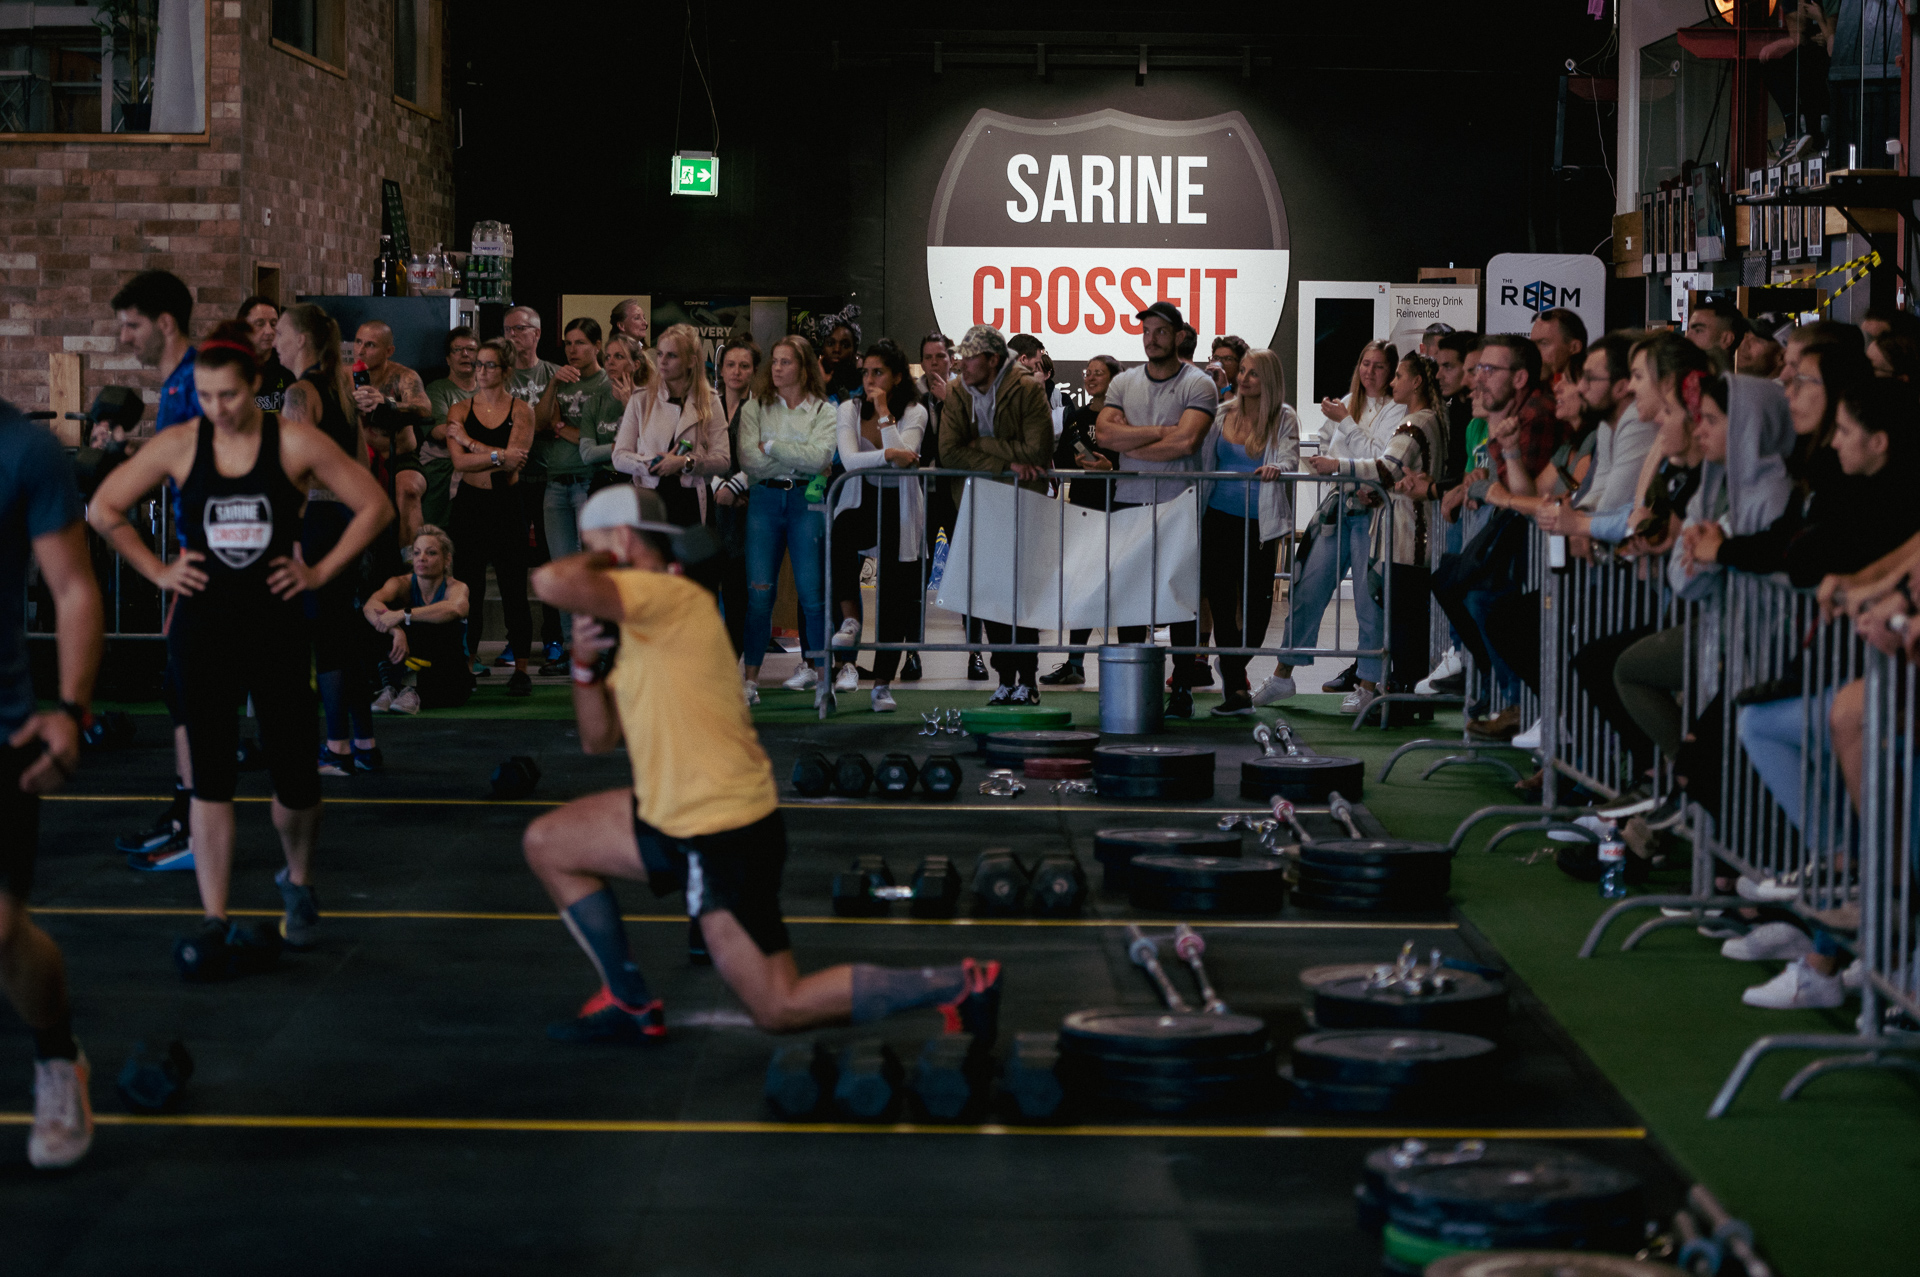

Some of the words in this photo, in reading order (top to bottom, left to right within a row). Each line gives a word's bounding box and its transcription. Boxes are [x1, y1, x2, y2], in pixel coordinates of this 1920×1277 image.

[1005, 153, 1208, 225] SARINE
[972, 265, 1238, 336] CROSSFIT
[1396, 295, 1411, 306] The
[1413, 296, 1440, 308] Energy
[1442, 296, 1463, 306] Drink
[1396, 308, 1440, 319] Reinvented
